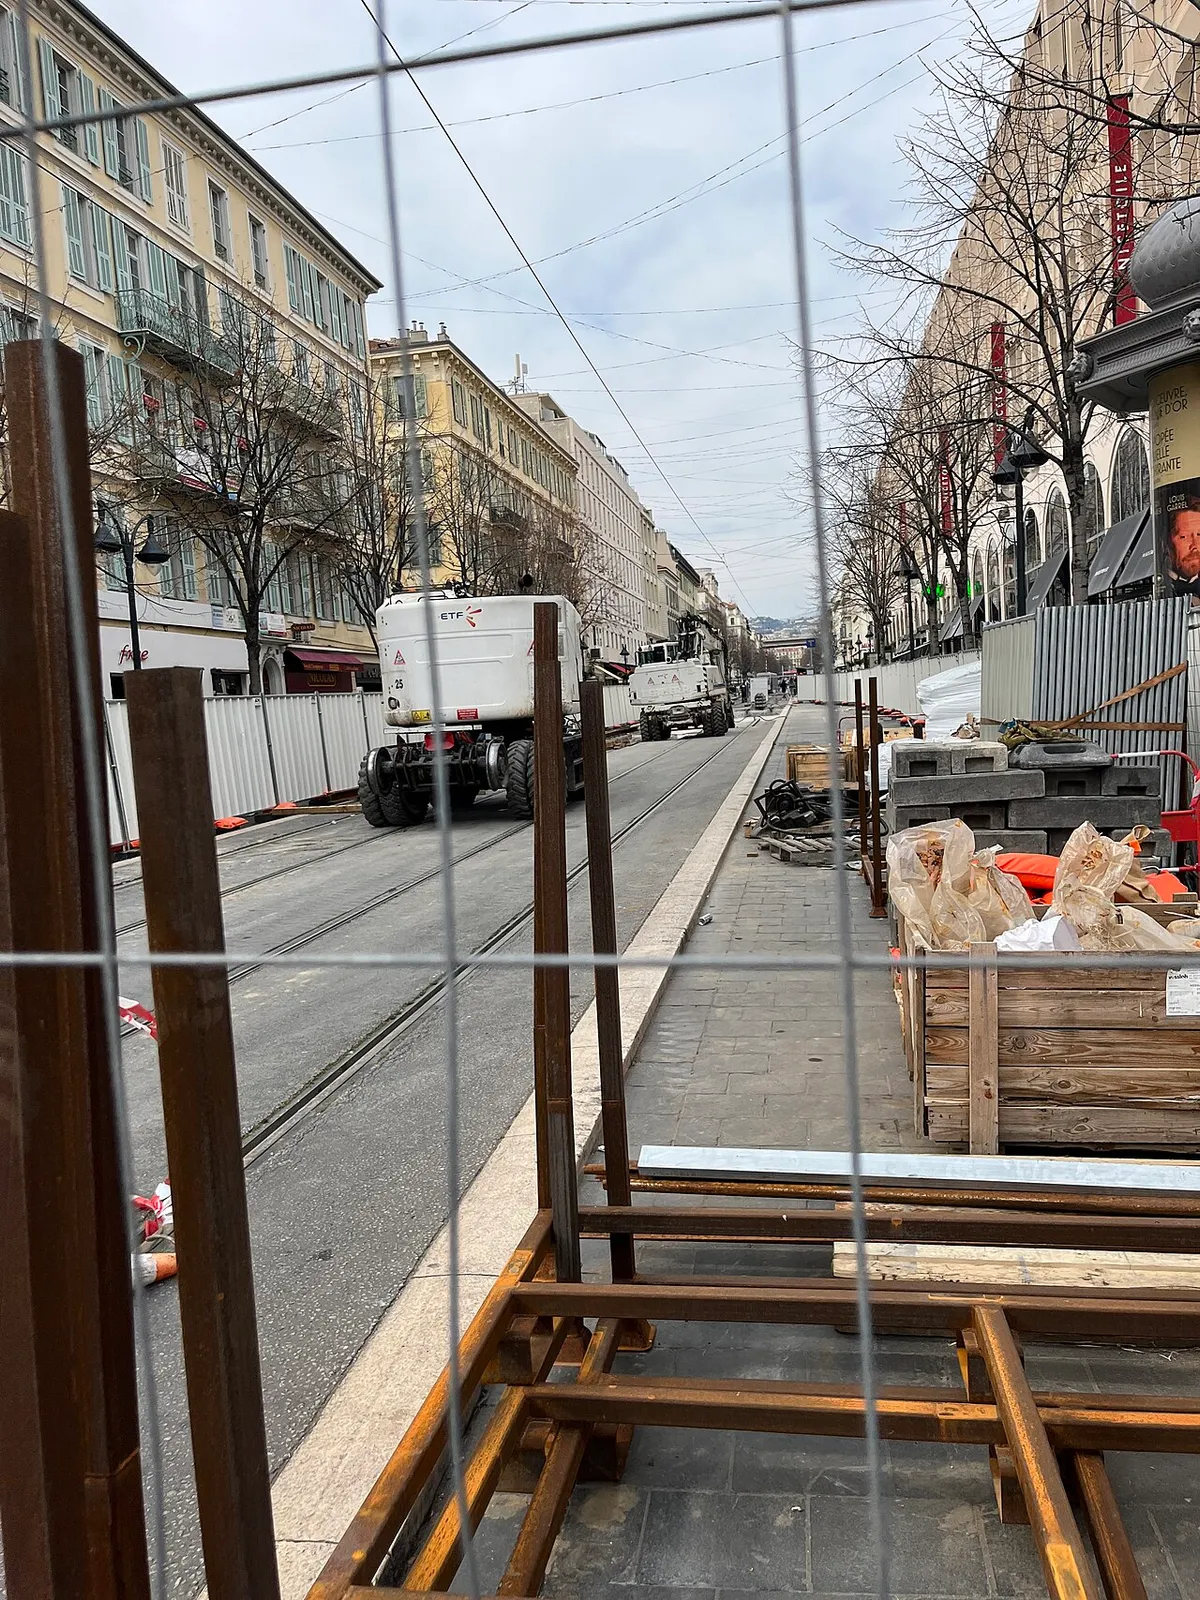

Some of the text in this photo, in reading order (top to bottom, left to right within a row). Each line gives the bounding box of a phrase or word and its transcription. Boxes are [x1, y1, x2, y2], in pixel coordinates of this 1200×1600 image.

[440, 611, 463, 620] ETF
[118, 644, 149, 665] fre
[395, 679, 403, 689] 25
